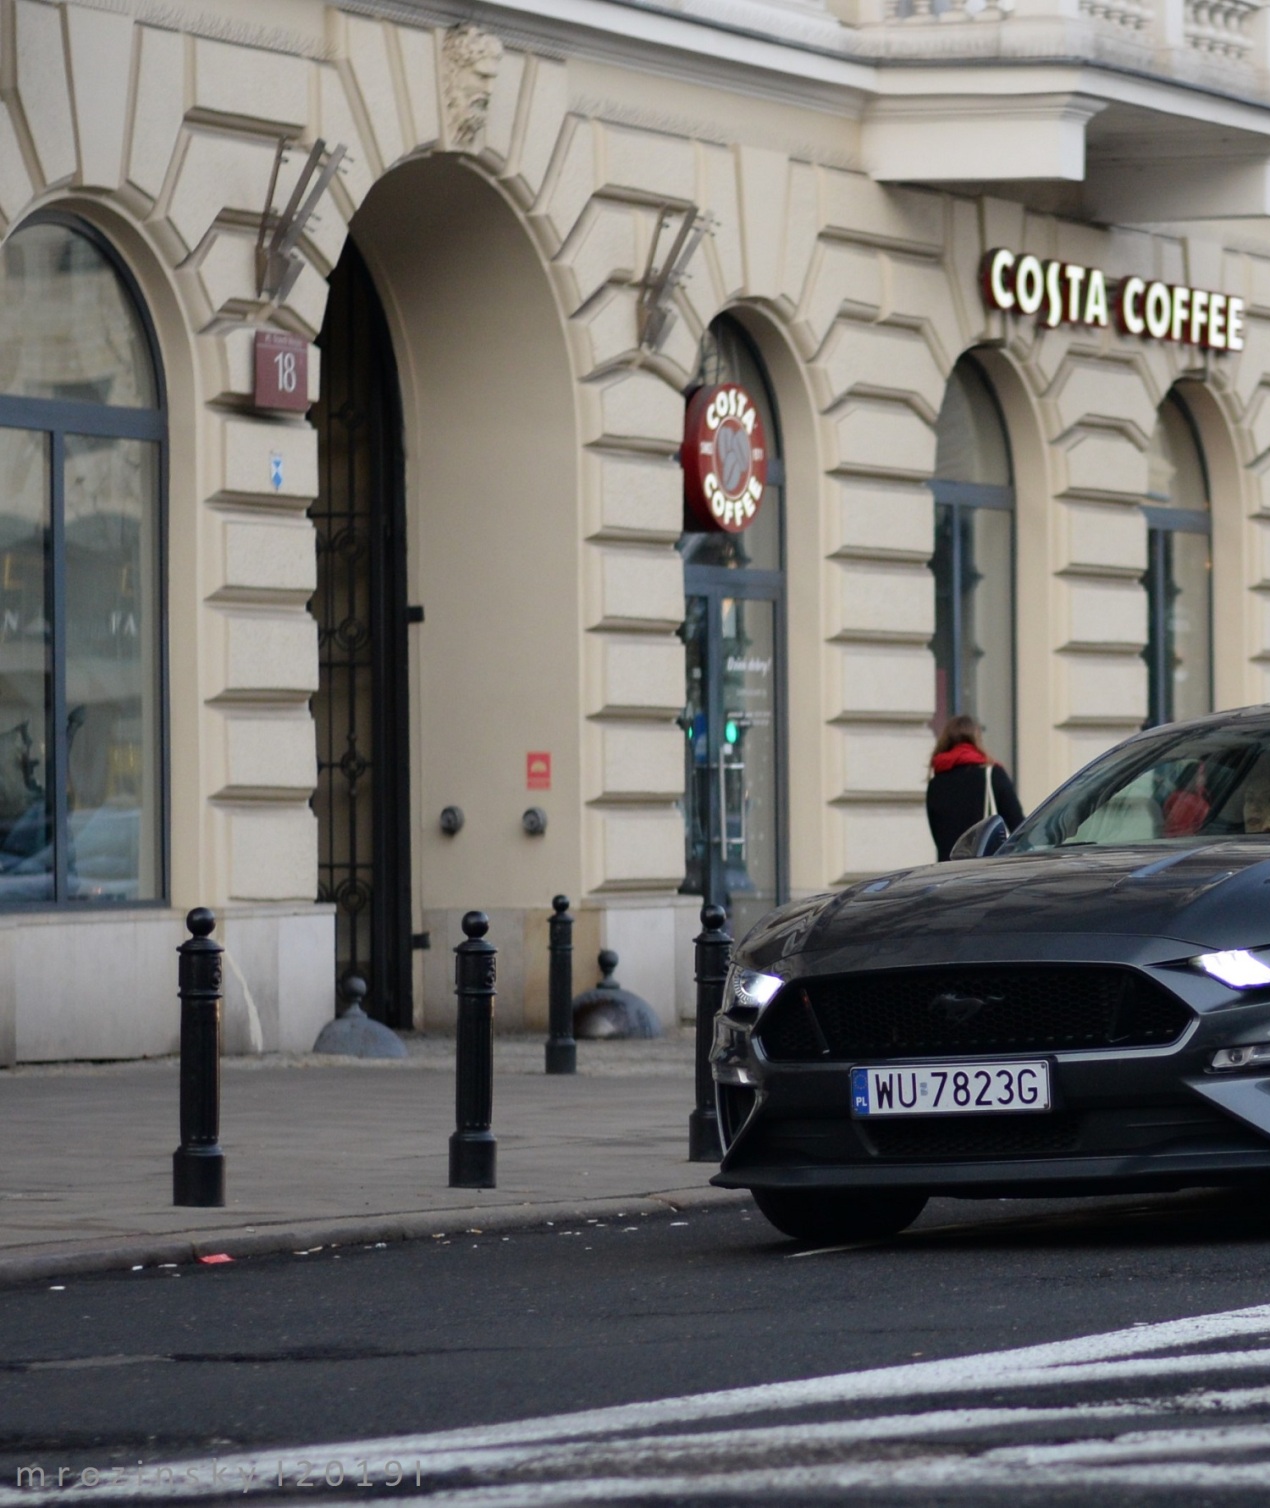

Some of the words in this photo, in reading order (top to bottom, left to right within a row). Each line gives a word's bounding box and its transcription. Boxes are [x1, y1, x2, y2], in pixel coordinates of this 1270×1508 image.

[991, 249, 1108, 328] COSTA
[1123, 276, 1244, 351] COFFEE
[274, 351, 297, 393] 18
[706, 388, 756, 435] COSTA
[704, 472, 763, 526] COFFEE
[855, 1096, 868, 1107] PL
[875, 1072, 917, 1109] WU
[931, 1069, 1038, 1107] 7823G
